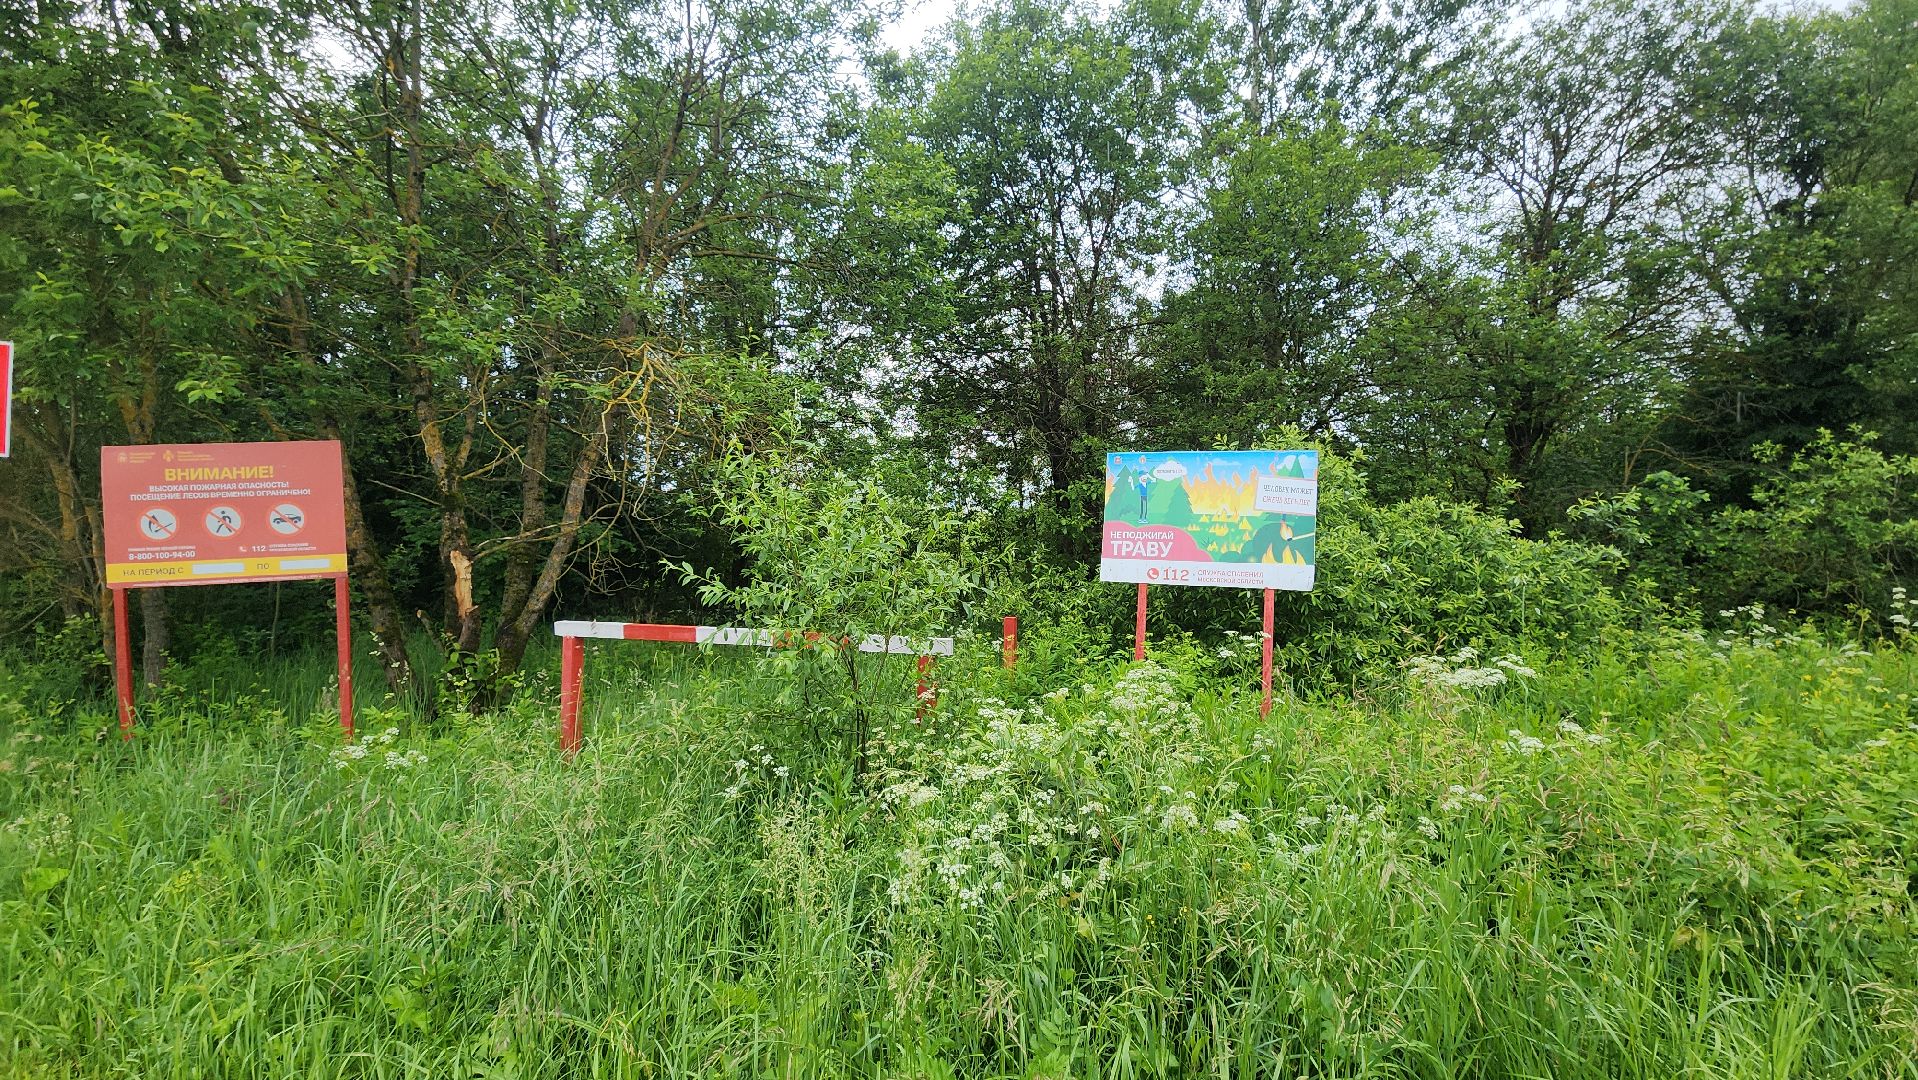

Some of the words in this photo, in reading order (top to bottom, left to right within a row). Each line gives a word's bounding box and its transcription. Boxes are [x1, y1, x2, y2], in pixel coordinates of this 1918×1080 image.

[164, 465, 274, 482] ВНИМАНИЕ!
[149, 484, 189, 493] ВЫСОКАЯ
[190, 482, 237, 491] ПОЖАРНАЯ
[238, 481, 289, 490] ОПАСНОСТЬ!
[1291, 487, 1314, 495] МОЖЕТ
[130, 492, 181, 502] ПОСЕЩЕНИЕ
[211, 490, 255, 498] ВРЕМЕННО
[256, 488, 311, 497] ОГРАНИЧЕНО!
[1111, 531, 1122, 539] НЕ
[1122, 530, 1174, 540] ПОДЖИГАЙ
[128, 550, 196, 561] 8-800-100-94-00
[1110, 540, 1173, 558] ТРАВУ
[138, 567, 176, 576] ПЕРИОД
[256, 562, 270, 570] ПО
[1163, 568, 1189, 581] 112
